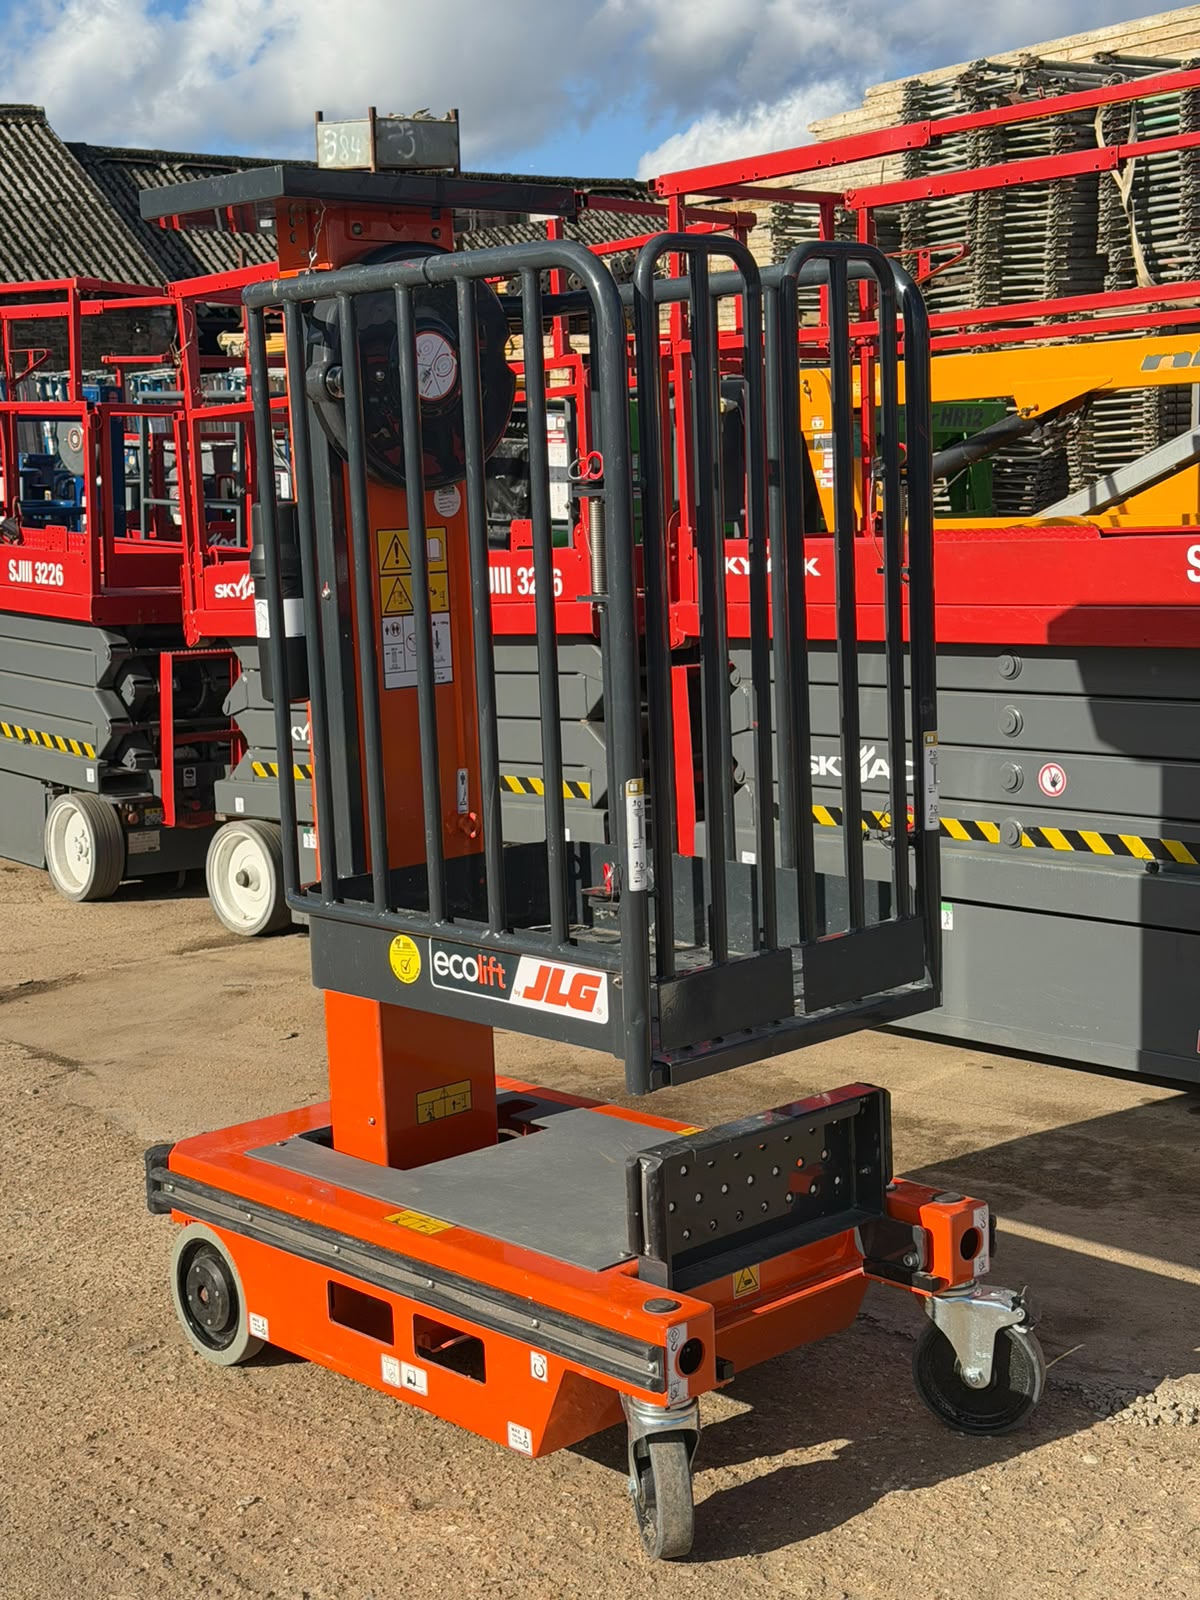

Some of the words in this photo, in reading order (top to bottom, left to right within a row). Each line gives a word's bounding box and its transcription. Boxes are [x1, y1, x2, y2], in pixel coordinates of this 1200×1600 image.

[324, 129, 361, 162] 384
[34, 561, 64, 587] 3226
[214, 573, 255, 600] SKYJA
[517, 566, 563, 597] 326
[433, 950, 506, 989] ecolift
[522, 964, 603, 1013] JLG
